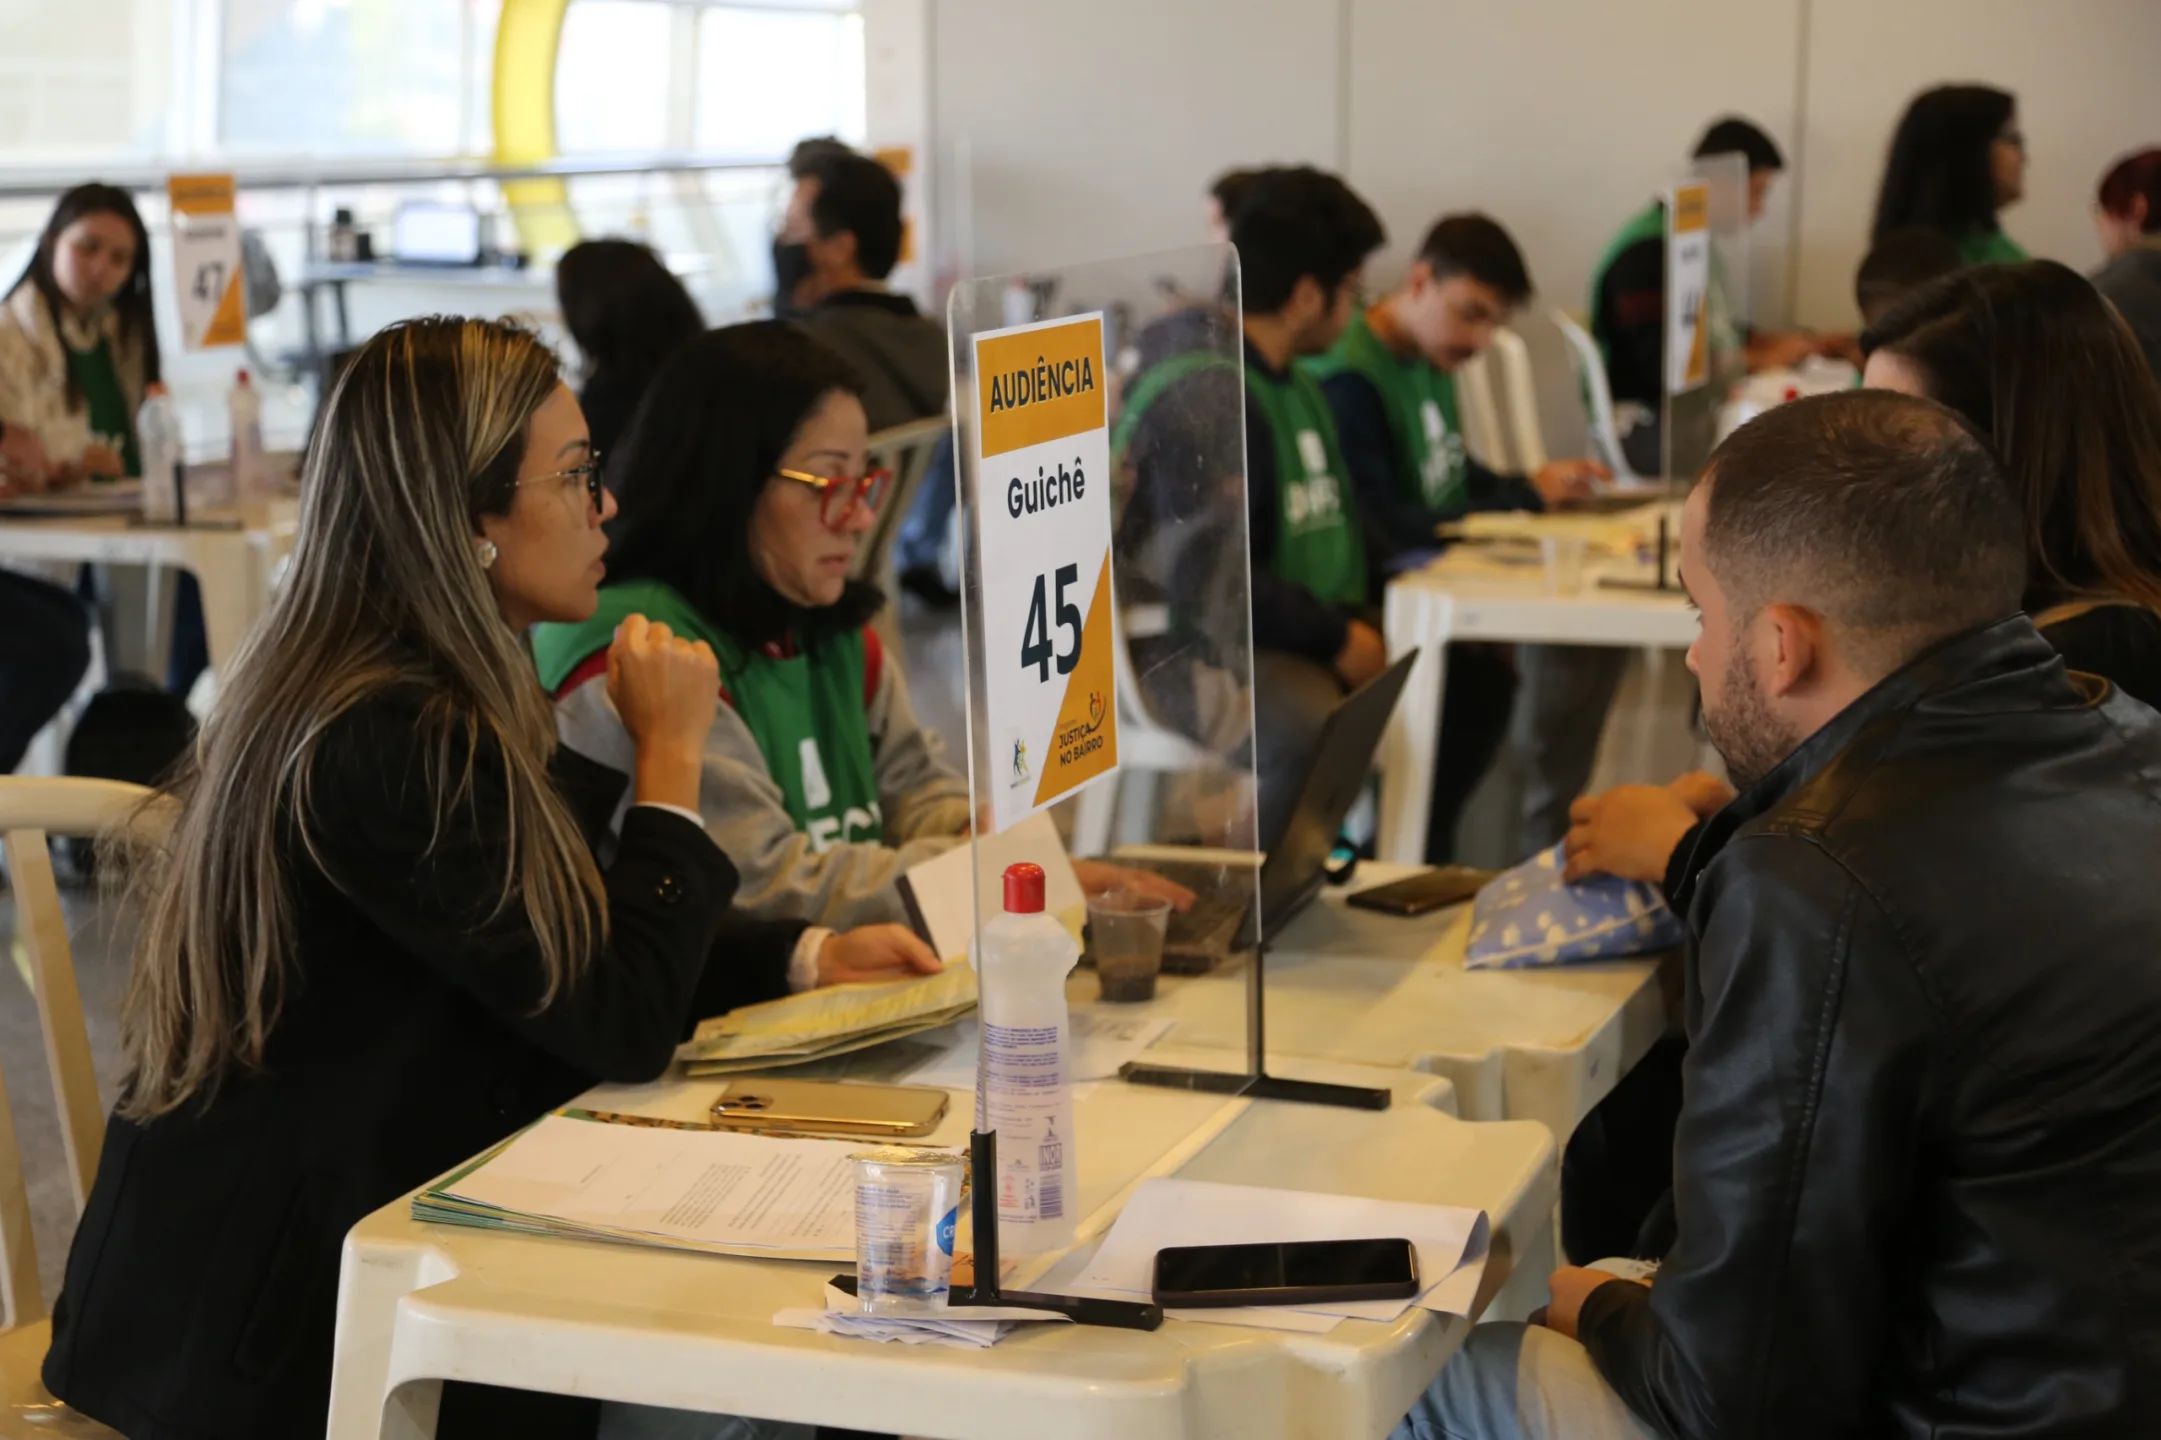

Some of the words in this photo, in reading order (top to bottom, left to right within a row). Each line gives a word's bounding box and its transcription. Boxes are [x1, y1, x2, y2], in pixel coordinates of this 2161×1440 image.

[990, 355, 1095, 413] AUDIÊNCIA
[1007, 456, 1085, 519] Guichê
[1021, 562, 1083, 684] 45
[1059, 722, 1092, 749] JUSTIÇA
[1060, 750, 1072, 768] NO
[1073, 735, 1104, 761] BAIRRO
